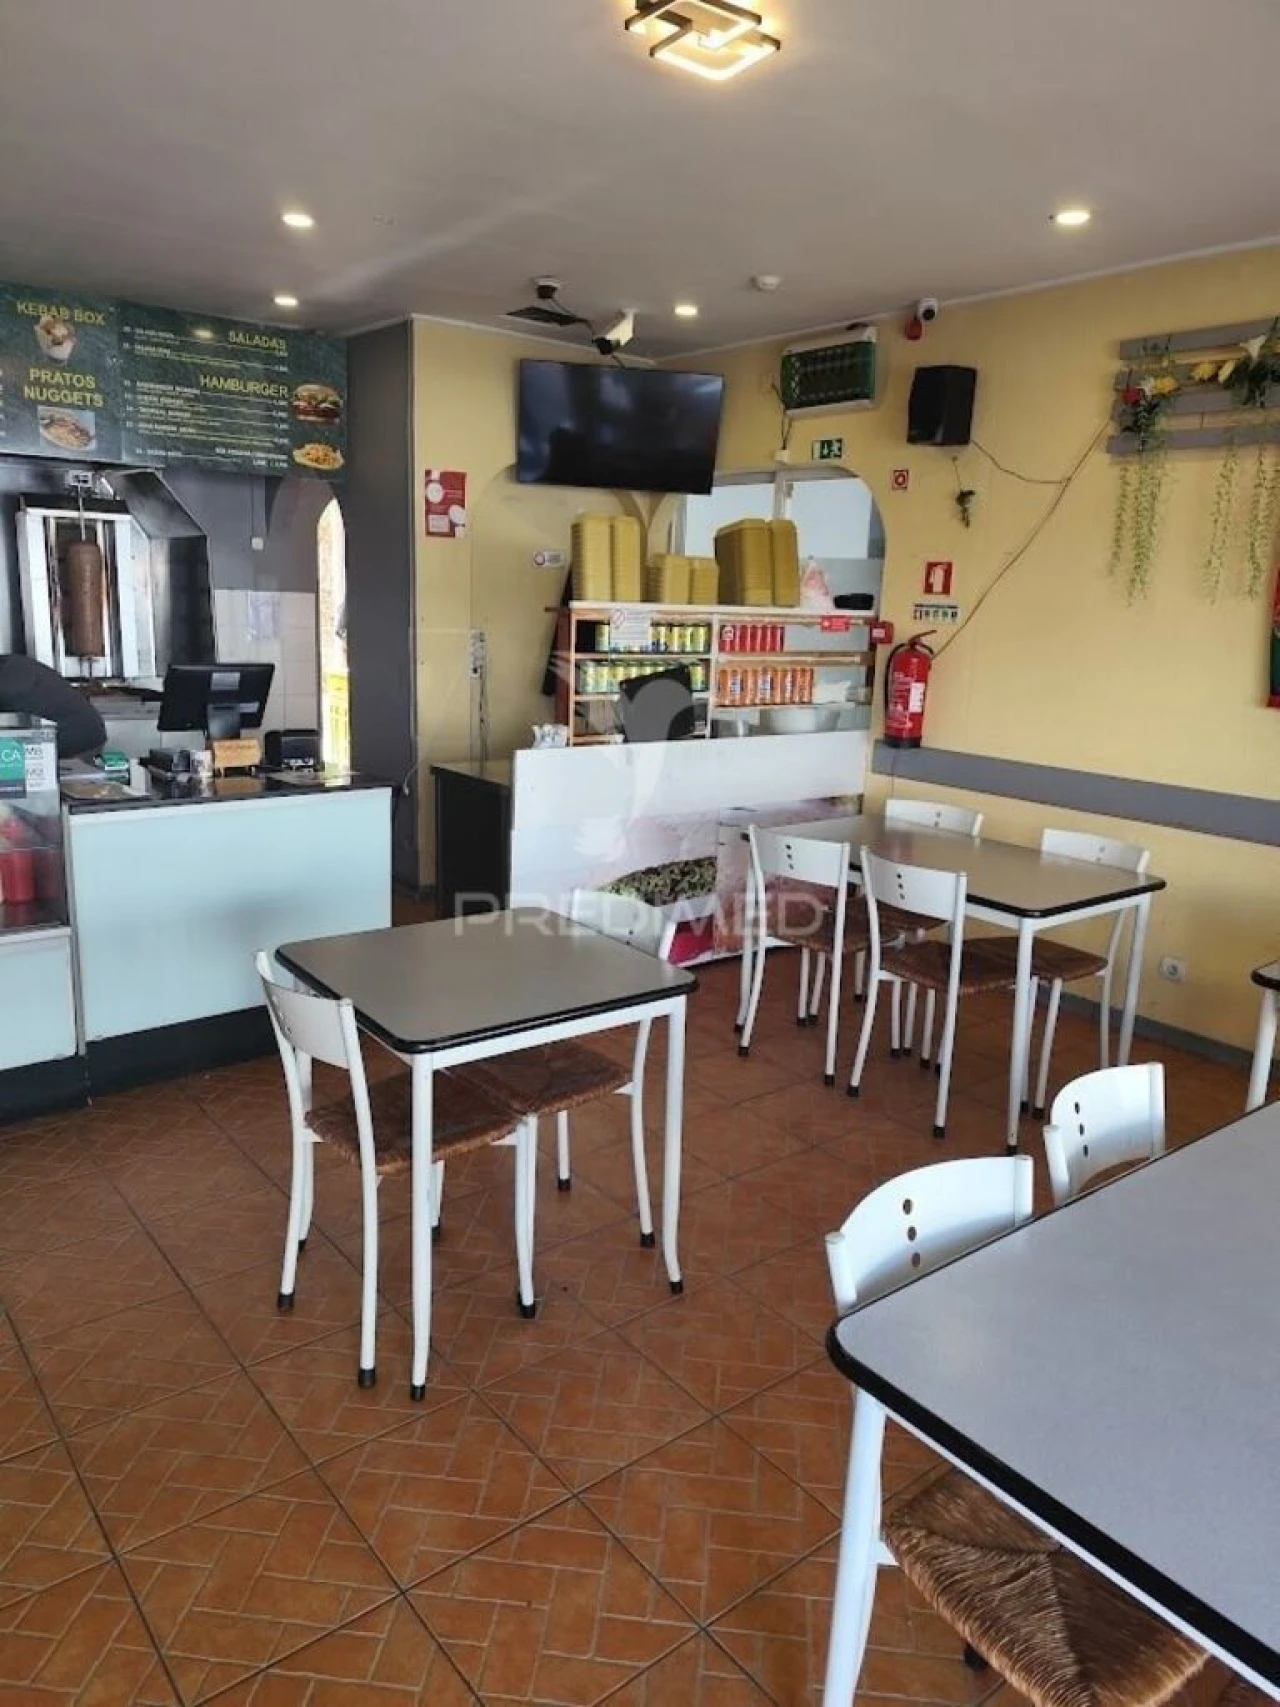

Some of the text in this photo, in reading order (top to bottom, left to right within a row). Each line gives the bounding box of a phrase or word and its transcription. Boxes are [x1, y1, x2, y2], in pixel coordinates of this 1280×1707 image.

[16, 300, 106, 325] KEBAB BOX
[228, 330, 286, 350] SALADAS
[29, 367, 96, 389] PRATOS
[200, 374, 289, 399] HAMBURGER
[23, 385, 104, 408] NUGGETS
